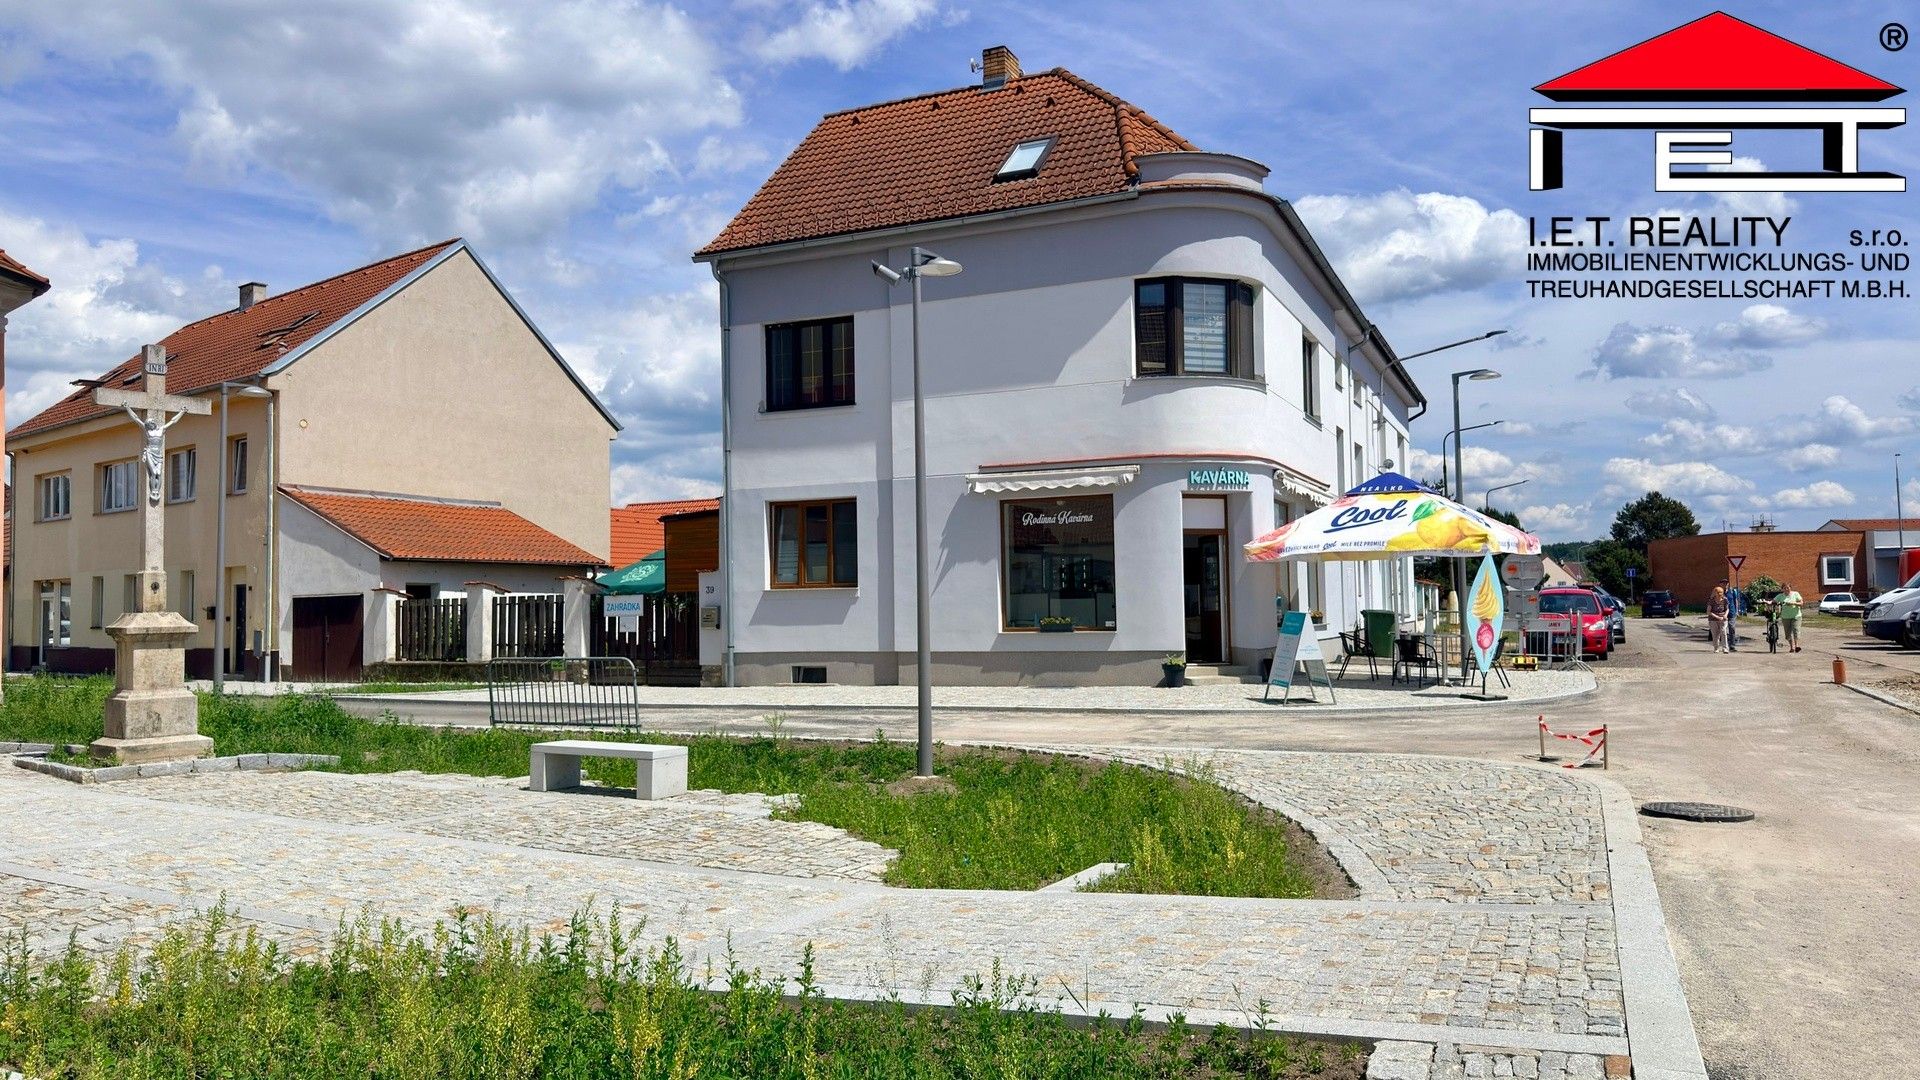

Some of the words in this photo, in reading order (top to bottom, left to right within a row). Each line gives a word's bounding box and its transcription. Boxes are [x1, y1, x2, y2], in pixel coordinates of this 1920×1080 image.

[149, 364, 165, 373] INRI
[1190, 467, 1250, 485] KAVÁRNA
[1022, 512, 1057, 526] Rodinná
[1058, 510, 1094, 525] Kavárna
[1330, 499, 1408, 529] Cool
[705, 585, 715, 594] 39
[606, 601, 641, 612] ZAHRÁDKA
